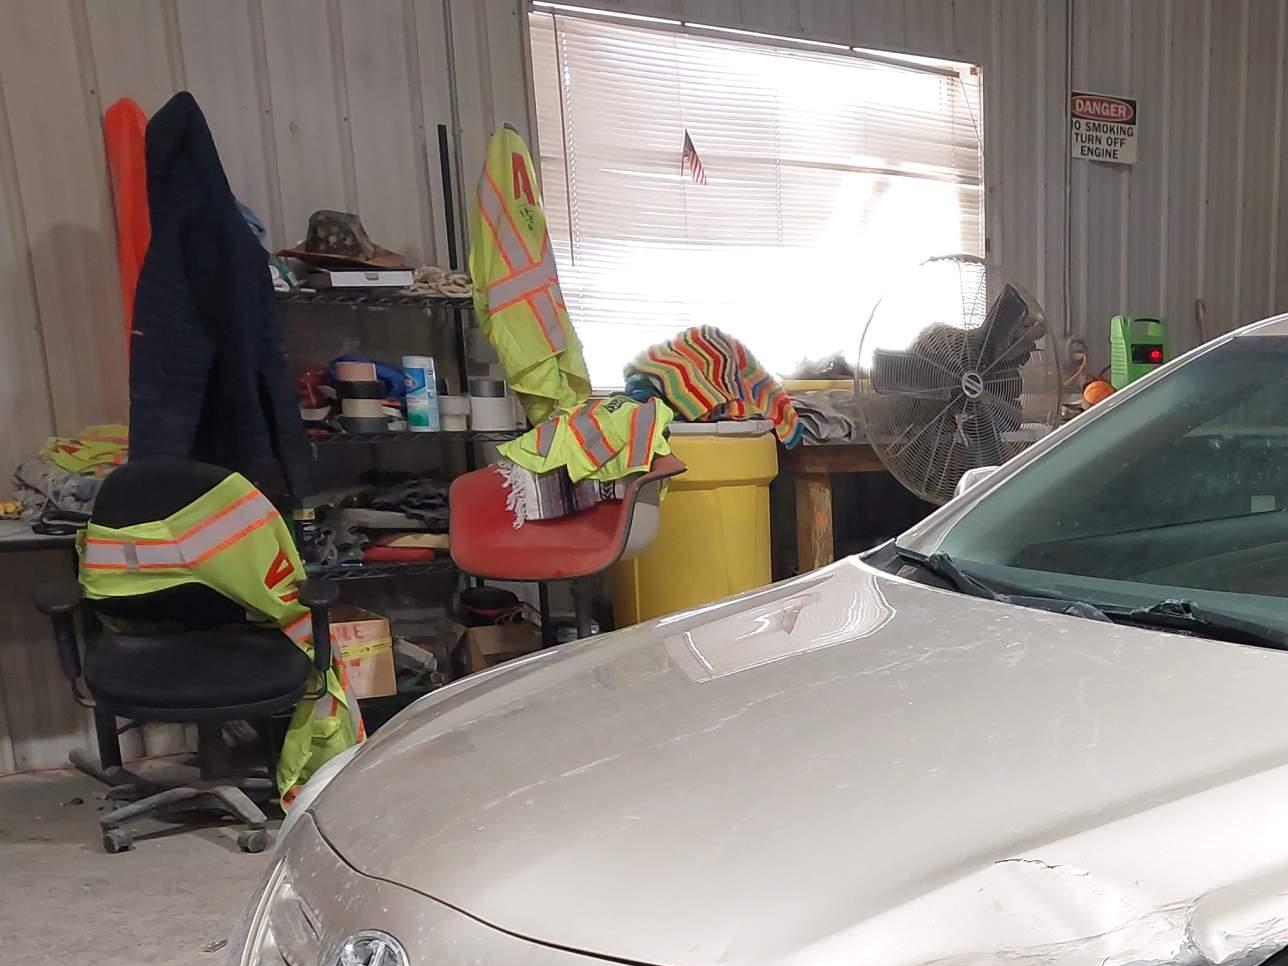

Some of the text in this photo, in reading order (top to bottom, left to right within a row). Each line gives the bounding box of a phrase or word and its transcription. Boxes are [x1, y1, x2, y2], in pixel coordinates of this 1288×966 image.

[1075, 99, 1126, 118] DANGER
[1085, 121, 1134, 137] SMOKING
[1074, 132, 1126, 148] TURN OFF
[1080, 145, 1119, 160] ENGINE
